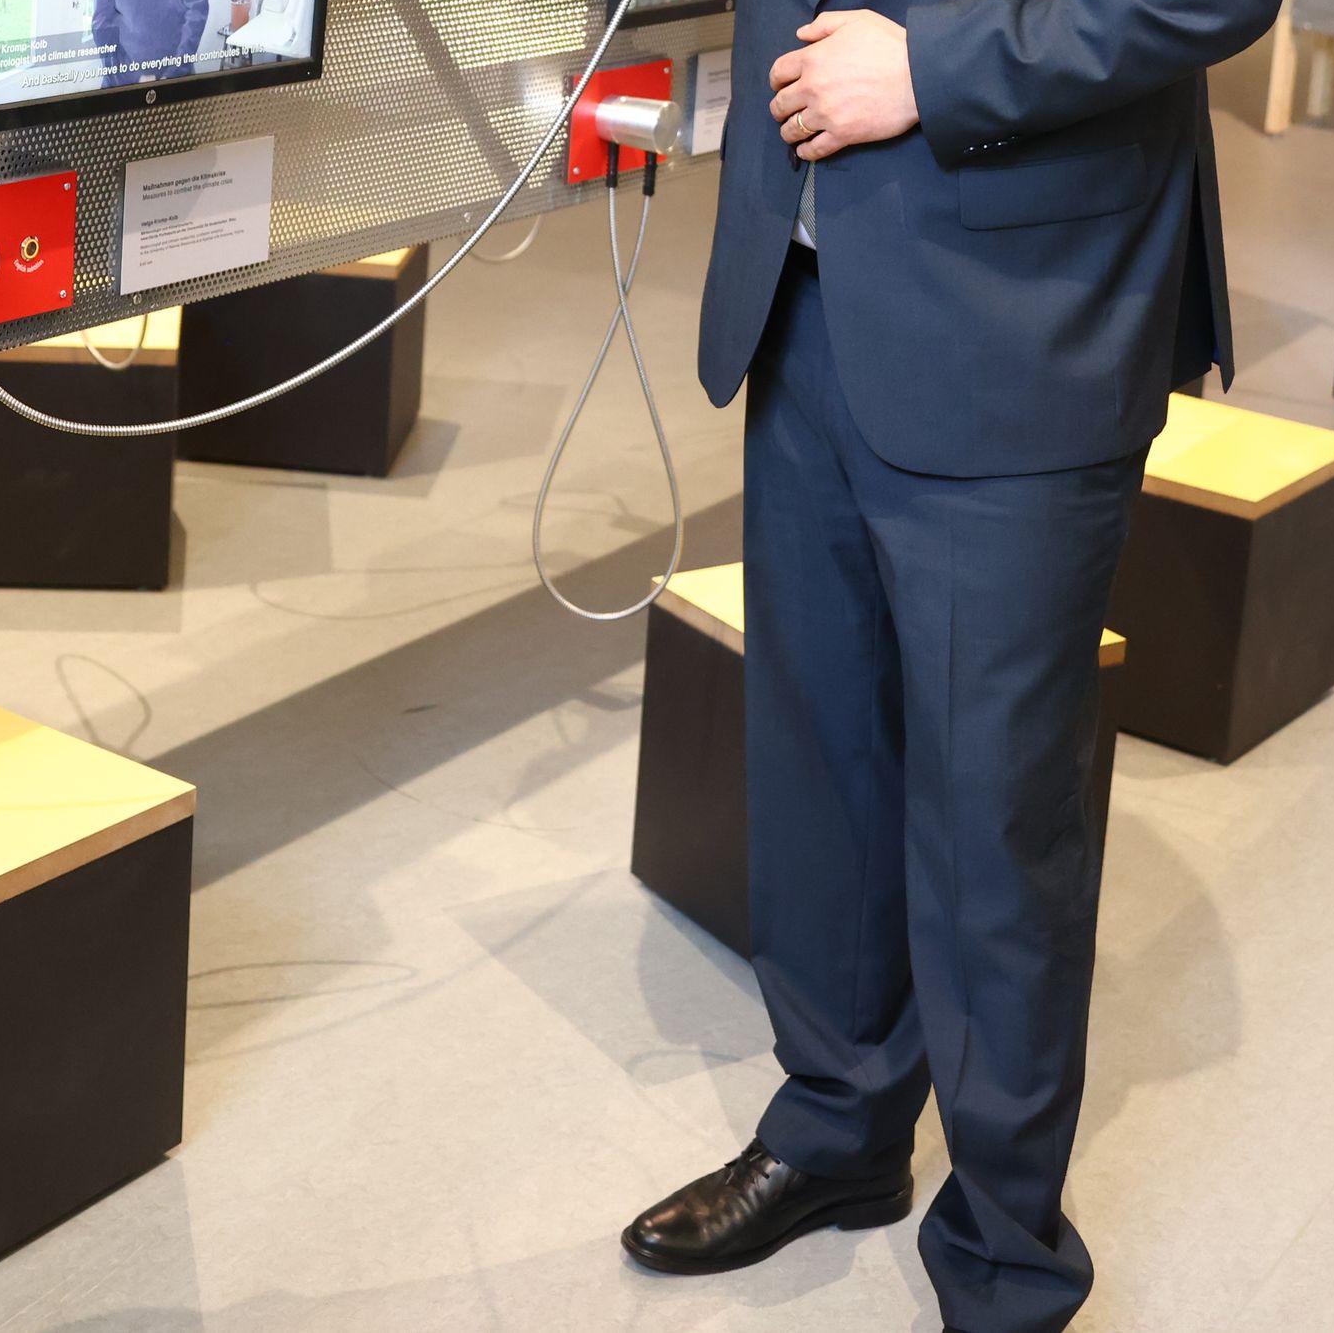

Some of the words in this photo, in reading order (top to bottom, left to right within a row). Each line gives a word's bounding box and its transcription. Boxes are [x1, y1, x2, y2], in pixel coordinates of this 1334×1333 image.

[1, 39, 48, 55] Kromp-Kolb
[32, 52, 46, 63] and
[48, 49, 76, 61] climate
[77, 43, 117, 57] researcher
[22, 76, 40, 88] And
[79, 69, 96, 82] you
[97, 64, 117, 75] have
[119, 62, 127, 73] to
[129, 61, 140, 71] do
[141, 55, 182, 70] everything
[183, 52, 198, 63] that
